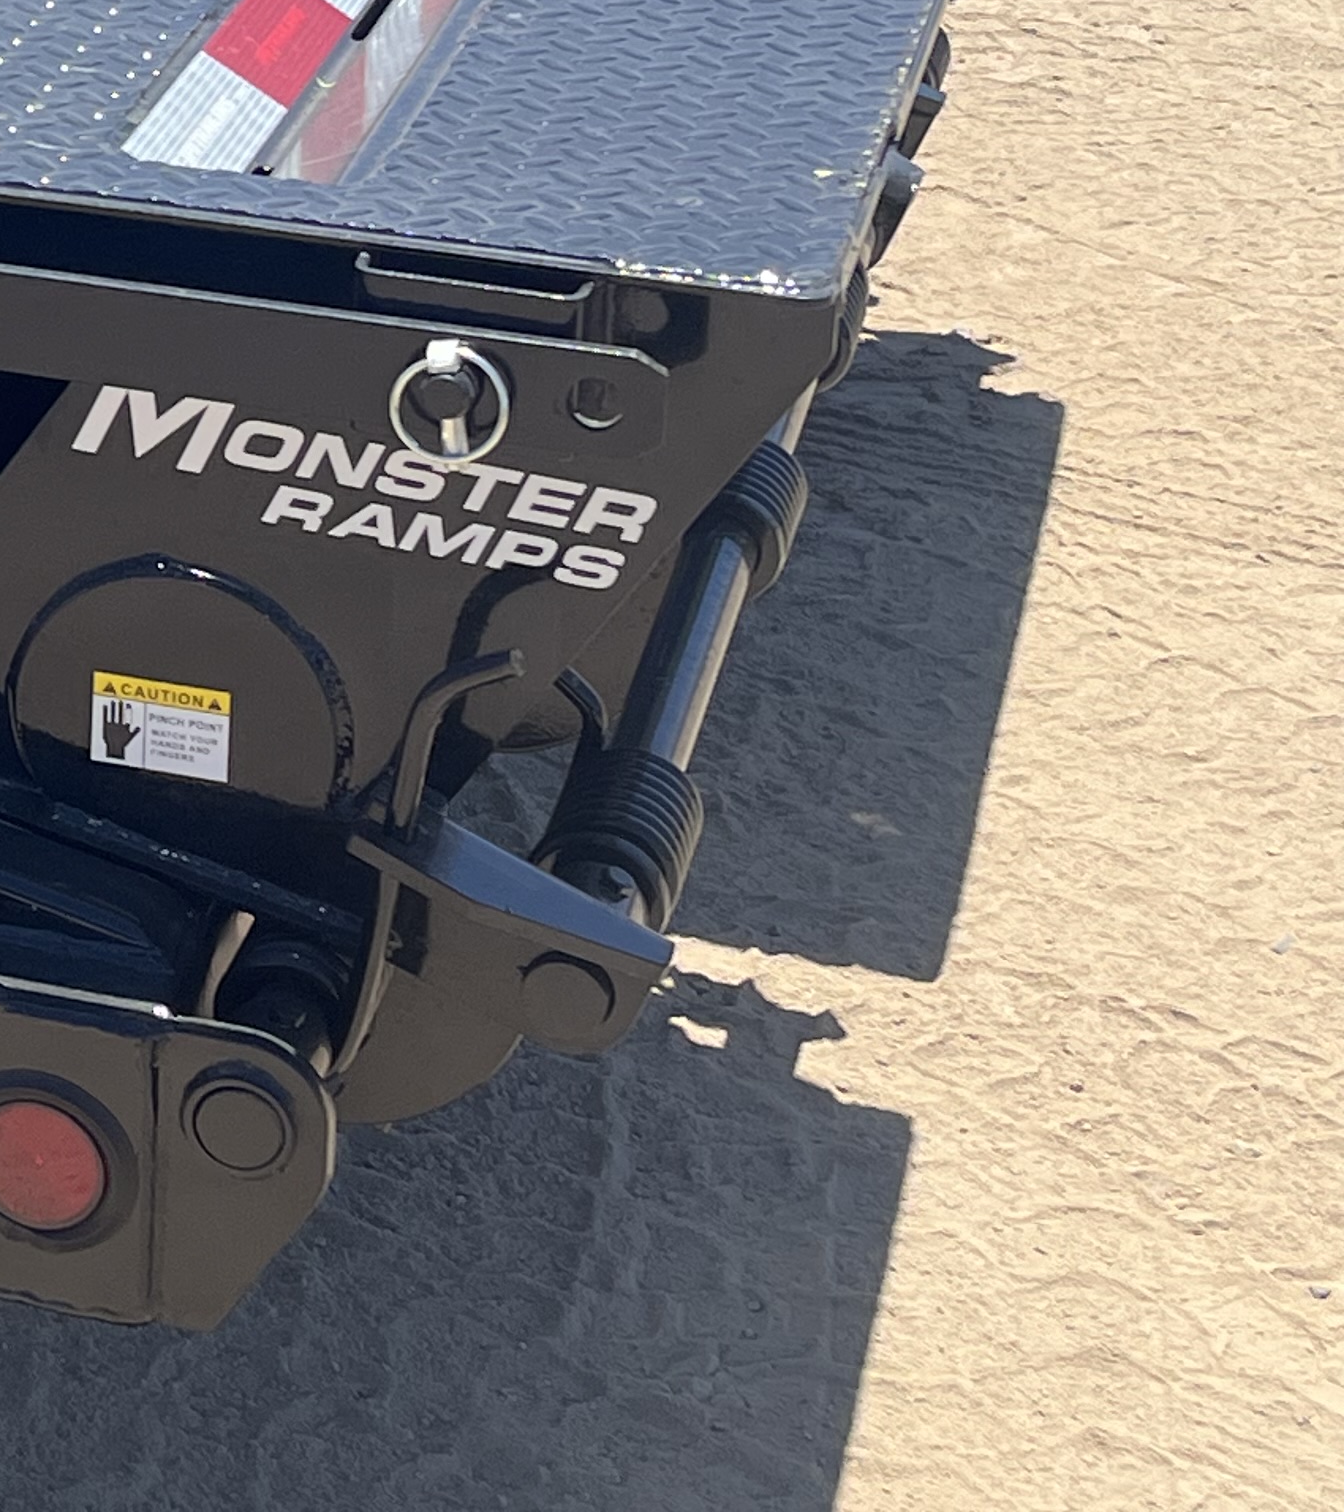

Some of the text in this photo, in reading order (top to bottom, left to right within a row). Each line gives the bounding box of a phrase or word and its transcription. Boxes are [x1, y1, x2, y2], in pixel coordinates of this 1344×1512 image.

[71, 385, 658, 543] MONSTER
[261, 485, 625, 589] RAMPS
[120, 682, 204, 708] CAUTION
[188, 719, 224, 733] POINT
